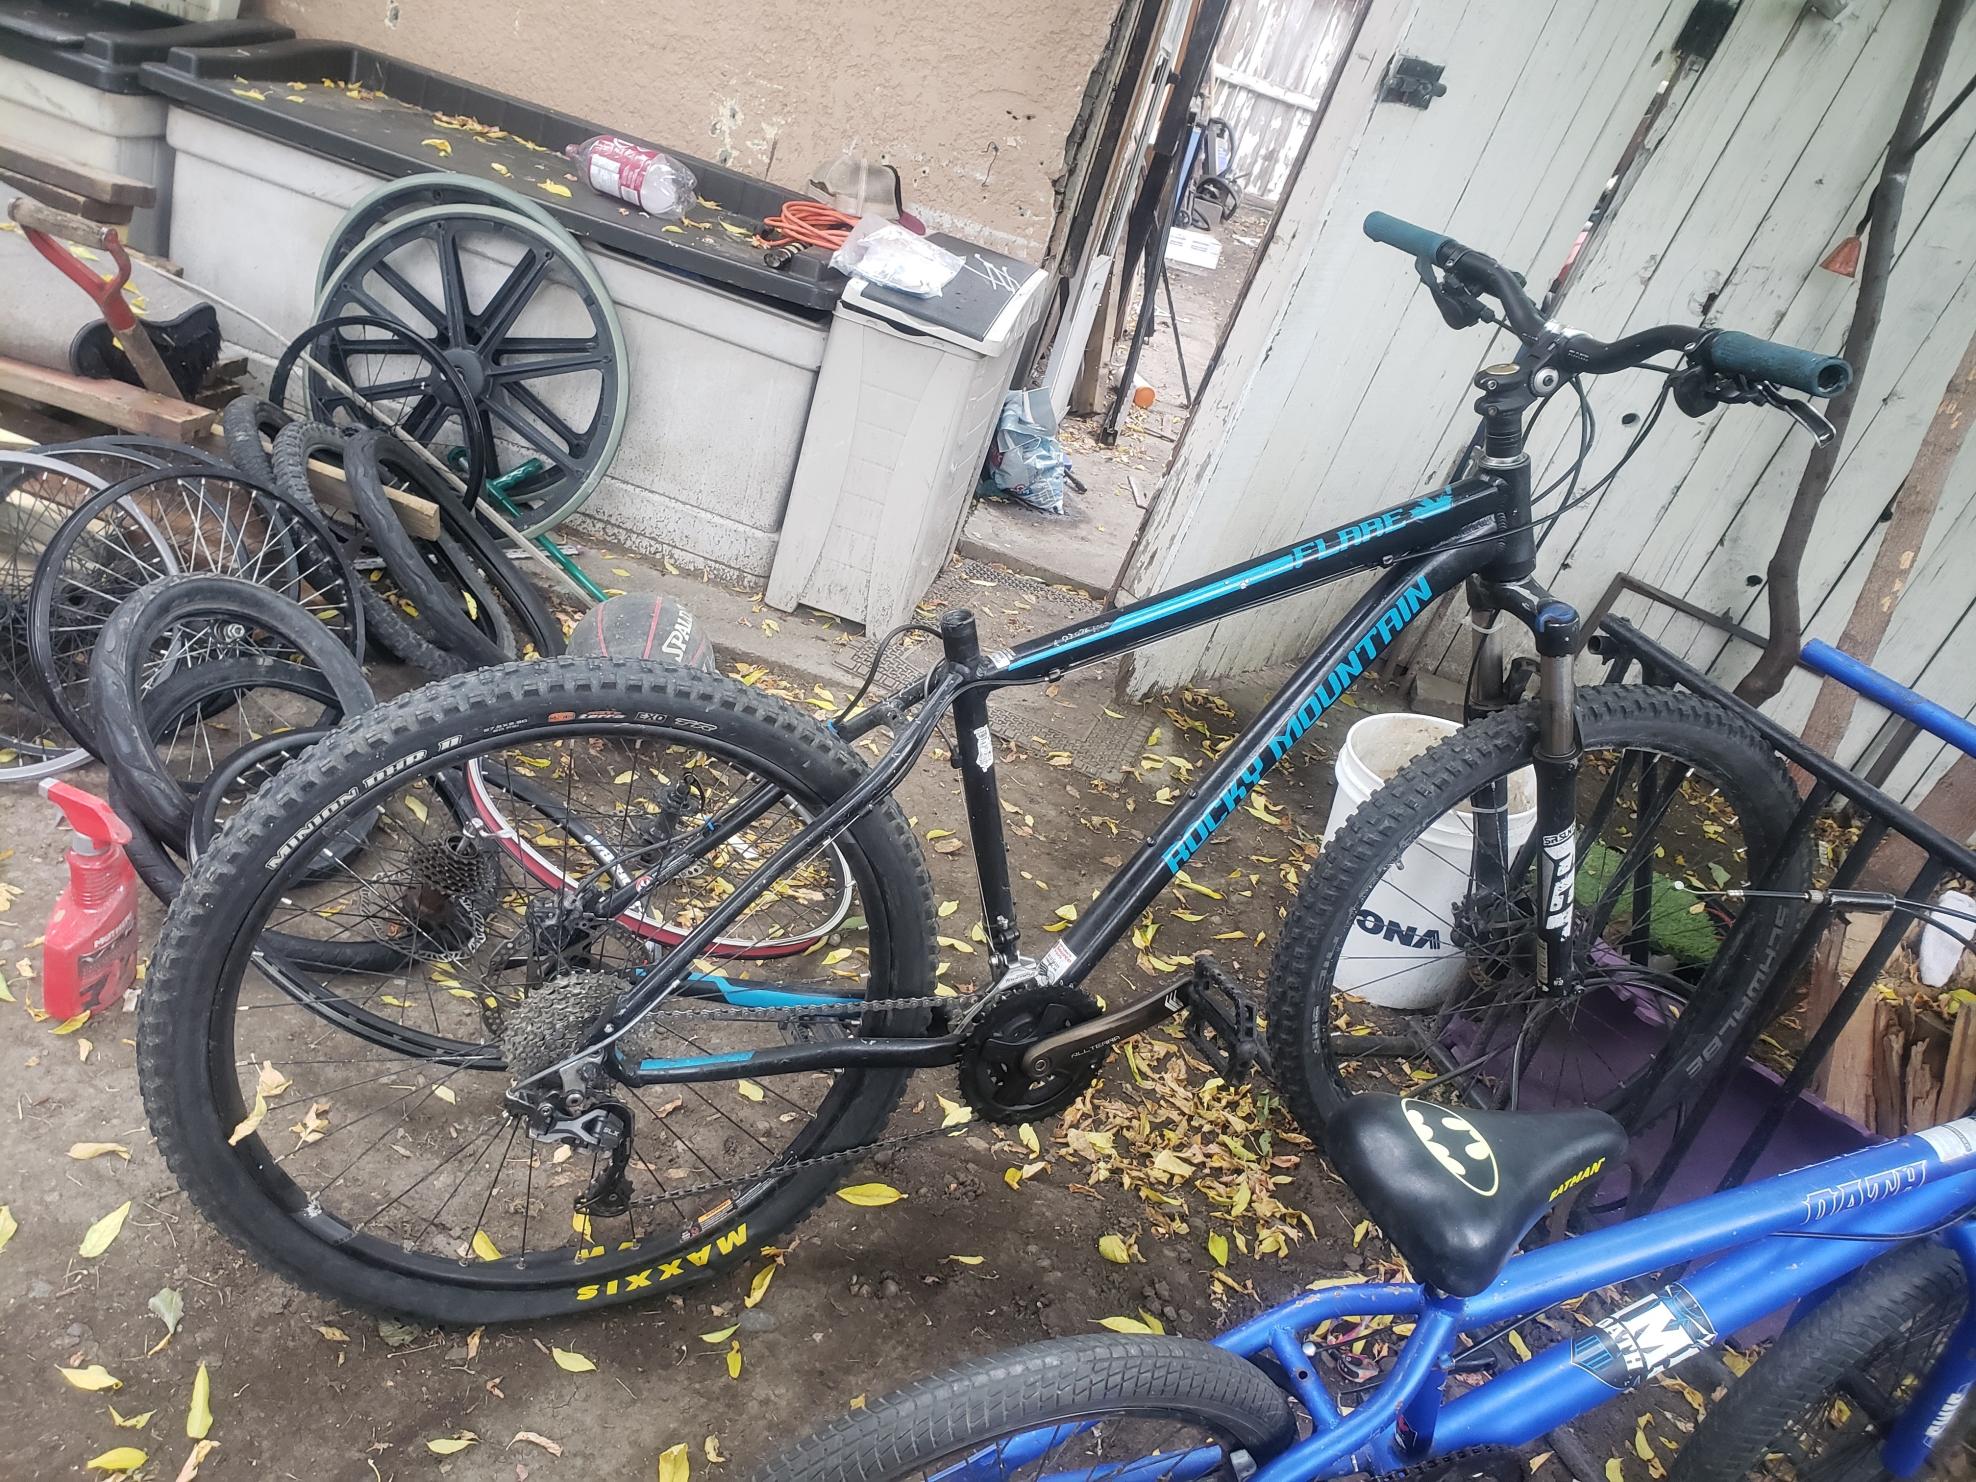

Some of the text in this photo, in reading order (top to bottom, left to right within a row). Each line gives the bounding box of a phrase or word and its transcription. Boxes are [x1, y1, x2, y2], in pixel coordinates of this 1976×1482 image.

[1291, 508, 1407, 569] FLARE
[636, 711, 667, 723] EXO
[1161, 574, 1434, 874] ROCKY MOUNTAIN
[265, 786, 360, 871] MINION
[1356, 909, 1440, 950] ONA
[603, 1127, 620, 1137] SLX
[1549, 1157, 1605, 1202] BATMAN
[576, 1223, 748, 1300] MAXXIS
